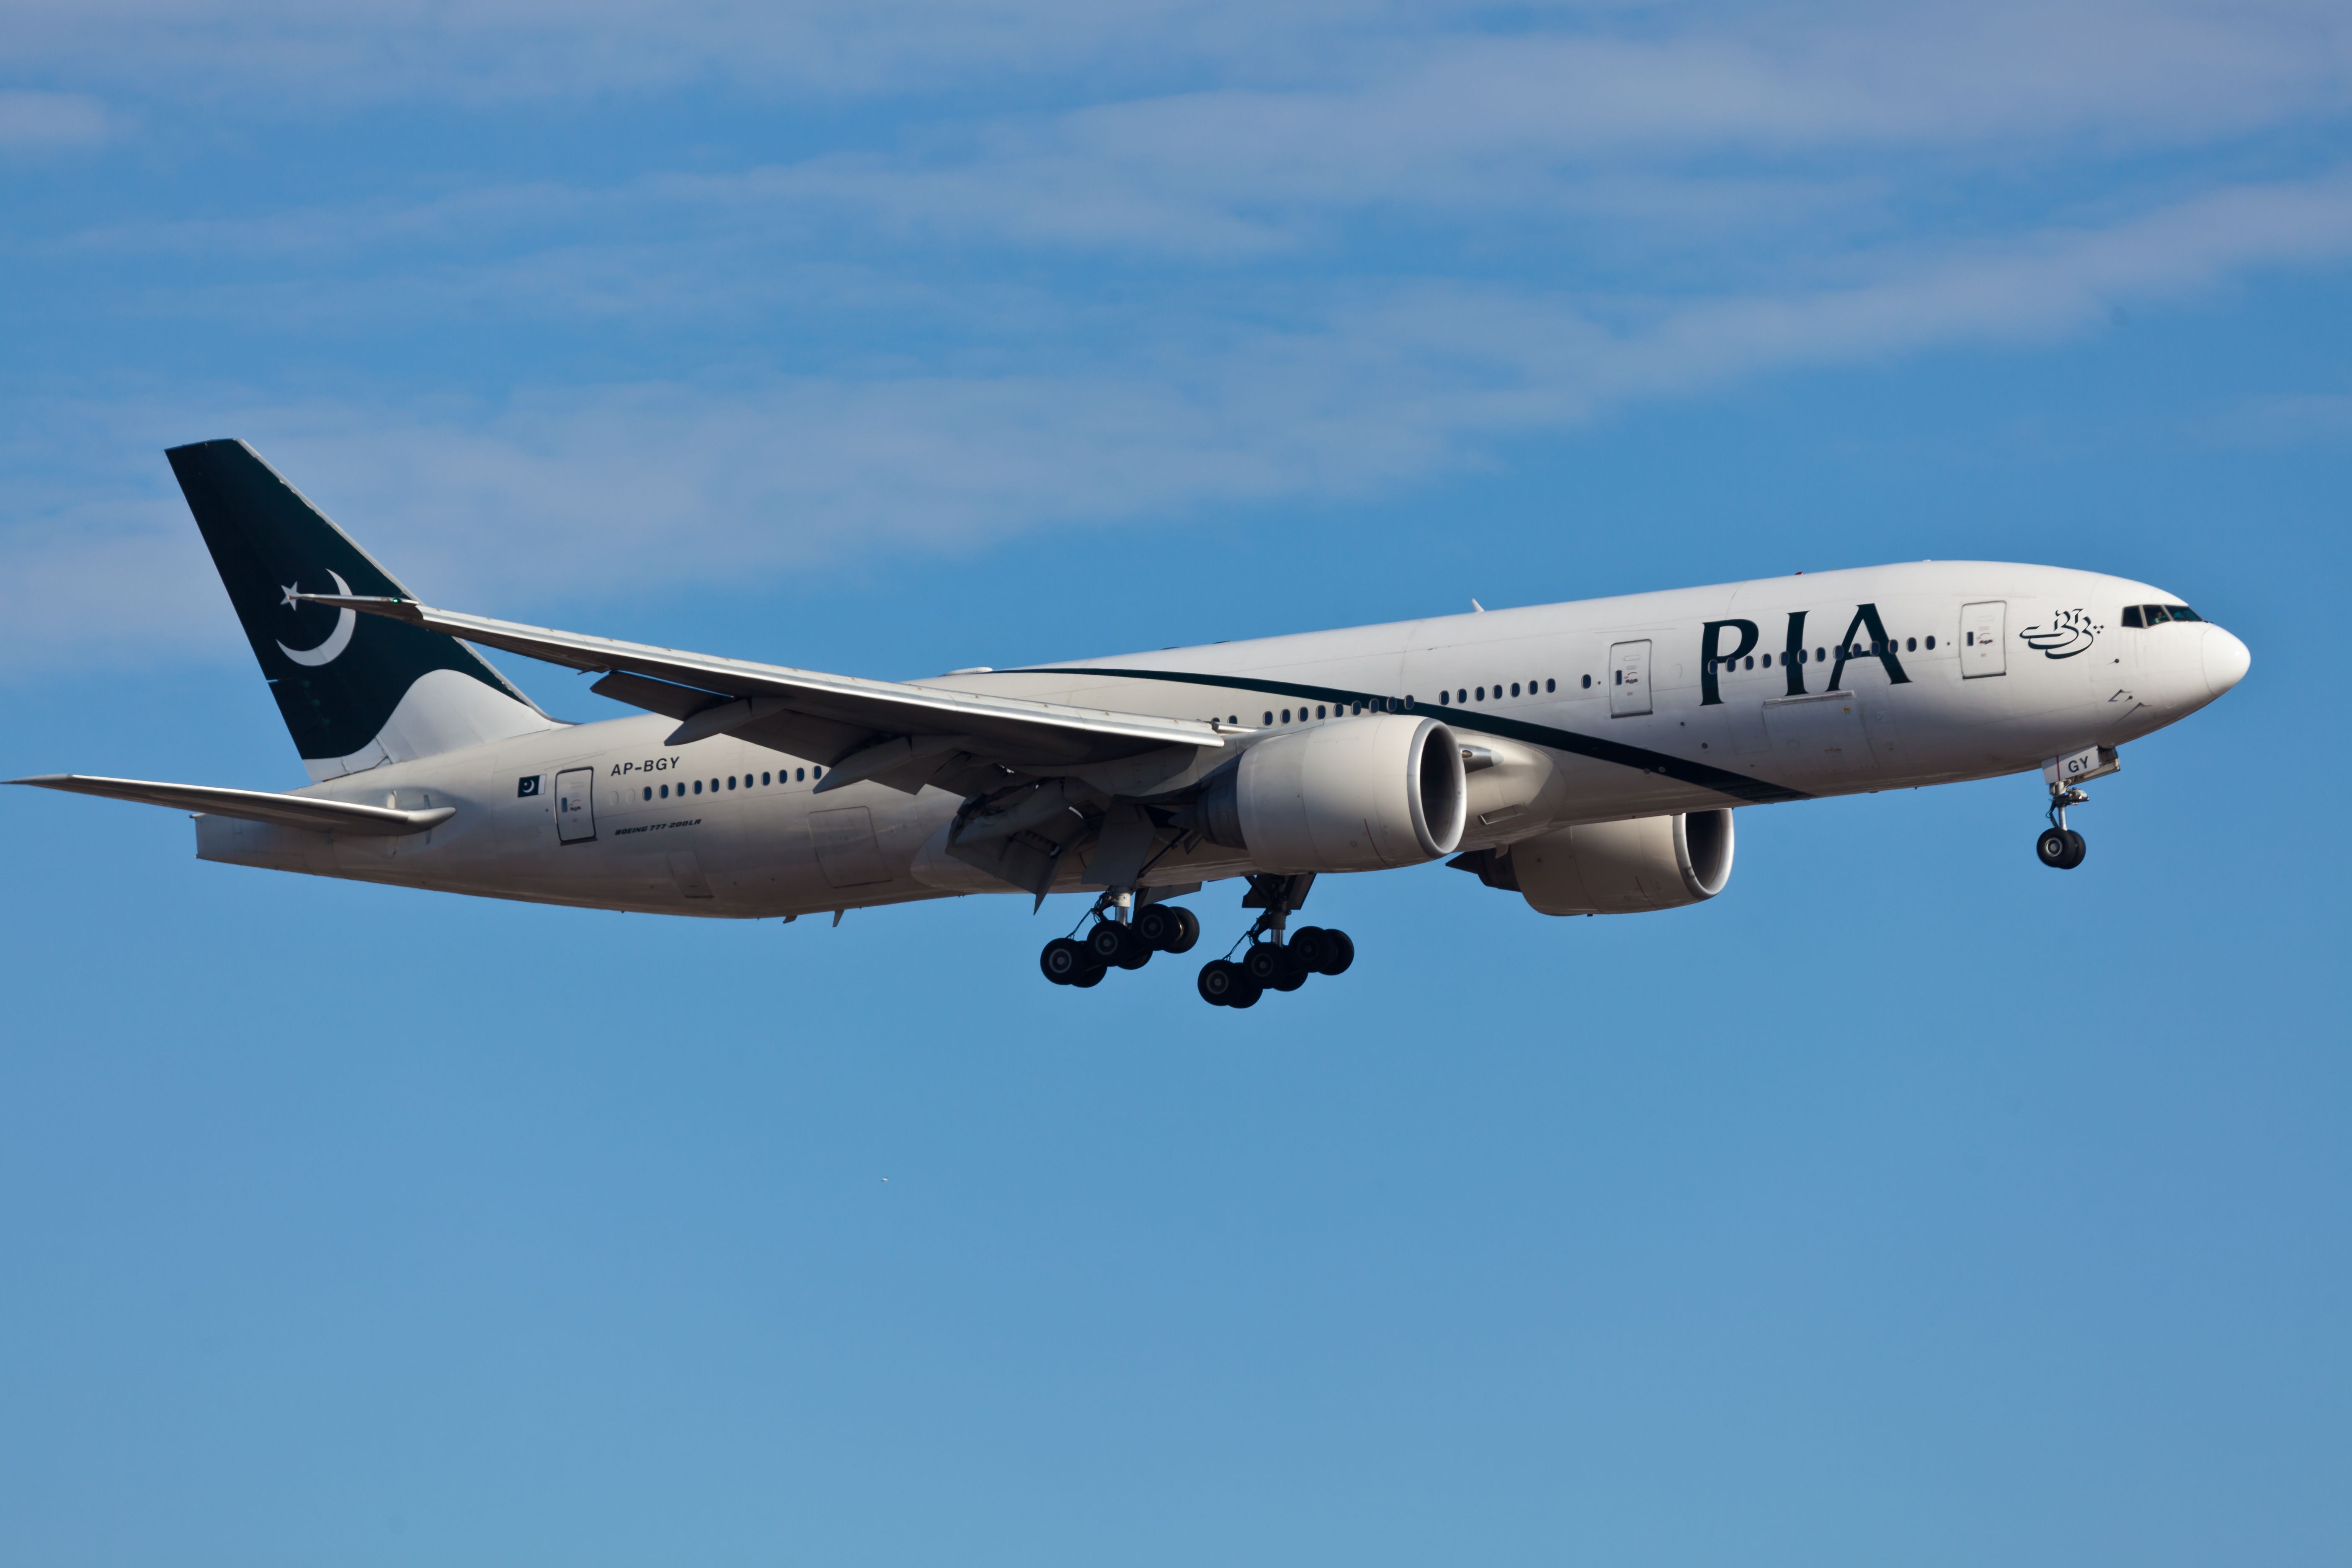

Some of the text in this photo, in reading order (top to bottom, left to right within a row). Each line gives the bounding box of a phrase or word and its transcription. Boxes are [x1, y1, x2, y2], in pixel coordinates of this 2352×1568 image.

[1700, 603, 1914, 706] PIA
[611, 756, 680, 776] AP-BGY
[2068, 756, 2089, 773] GY
[615, 819, 702, 835] BOEING 777-200LR
